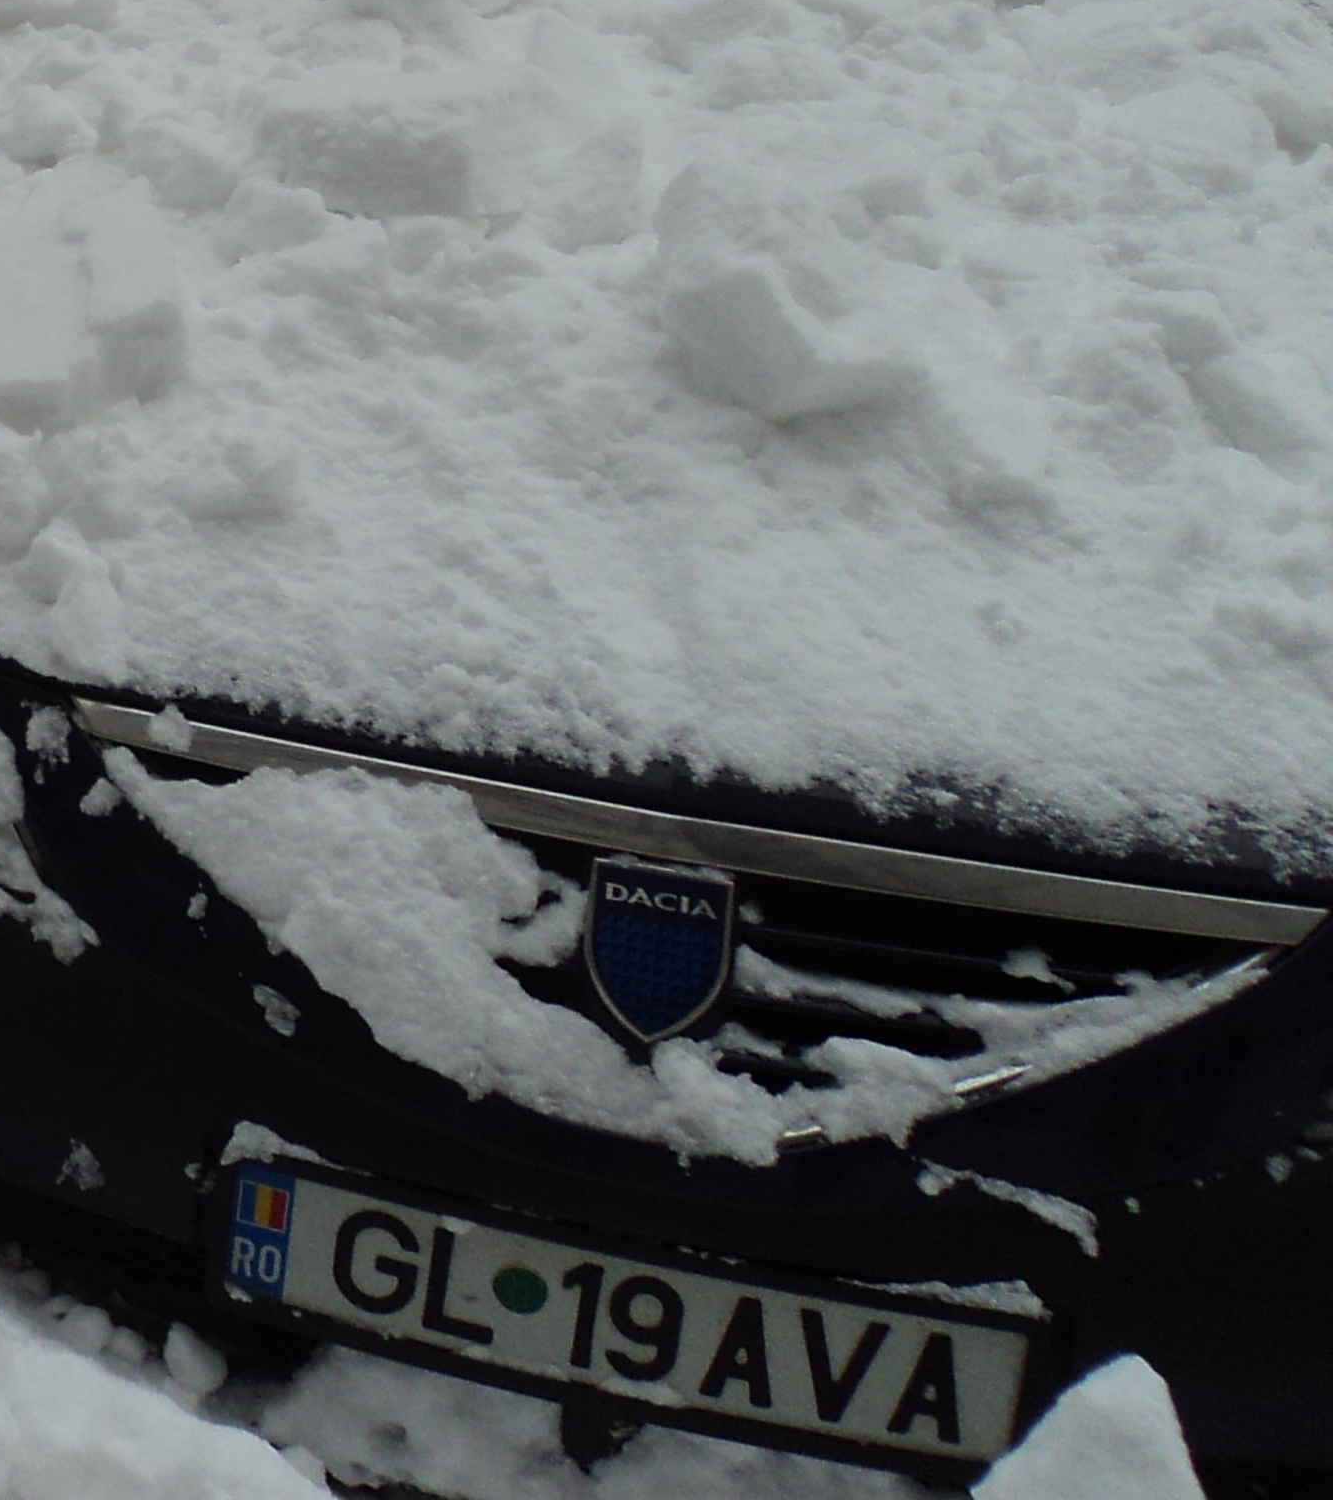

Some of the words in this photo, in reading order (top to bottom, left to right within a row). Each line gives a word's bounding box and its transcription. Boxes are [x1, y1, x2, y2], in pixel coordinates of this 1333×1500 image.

[605, 881, 718, 920] DACIA
[230, 1235, 283, 1284] RO
[333, 1208, 494, 1346] GL
[561, 1261, 685, 1383] 19
[698, 1295, 962, 1445] AVA
